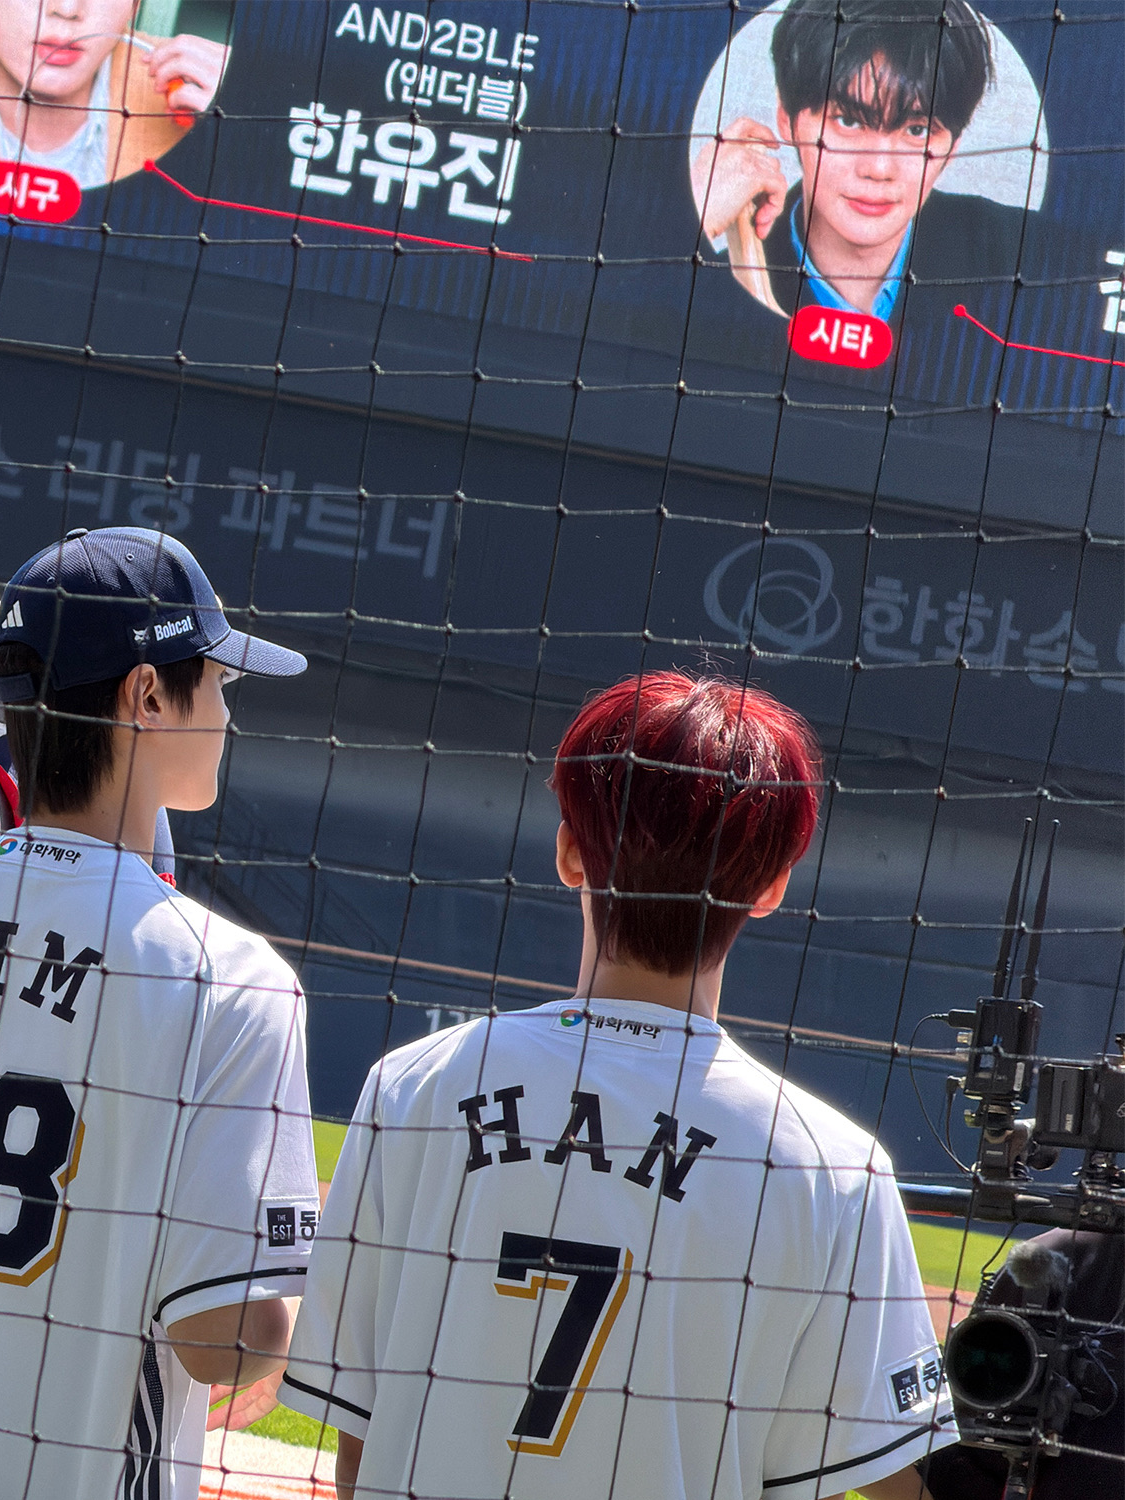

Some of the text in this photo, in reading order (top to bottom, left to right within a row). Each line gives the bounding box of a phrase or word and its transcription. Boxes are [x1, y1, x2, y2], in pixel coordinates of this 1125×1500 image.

[335, 3, 539, 72] AND2BLE
[385, 58, 527, 123] (앤더블)
[288, 101, 521, 225] 한유진
[809, 317, 874, 359] 시타
[47, 435, 201, 534] 리딩
[220, 466, 448, 579] 파트너
[154, 615, 193, 641] Bobcat
[861, 575, 1125, 694] 한화손
[19, 841, 82, 865] 대화제약
[587, 1014, 661, 1039] 대화제약
[457, 1084, 718, 1203] HAN
[272, 1224, 292, 1240] EST
[492, 1231, 633, 1458] 7
[899, 1384, 918, 1404] EST
